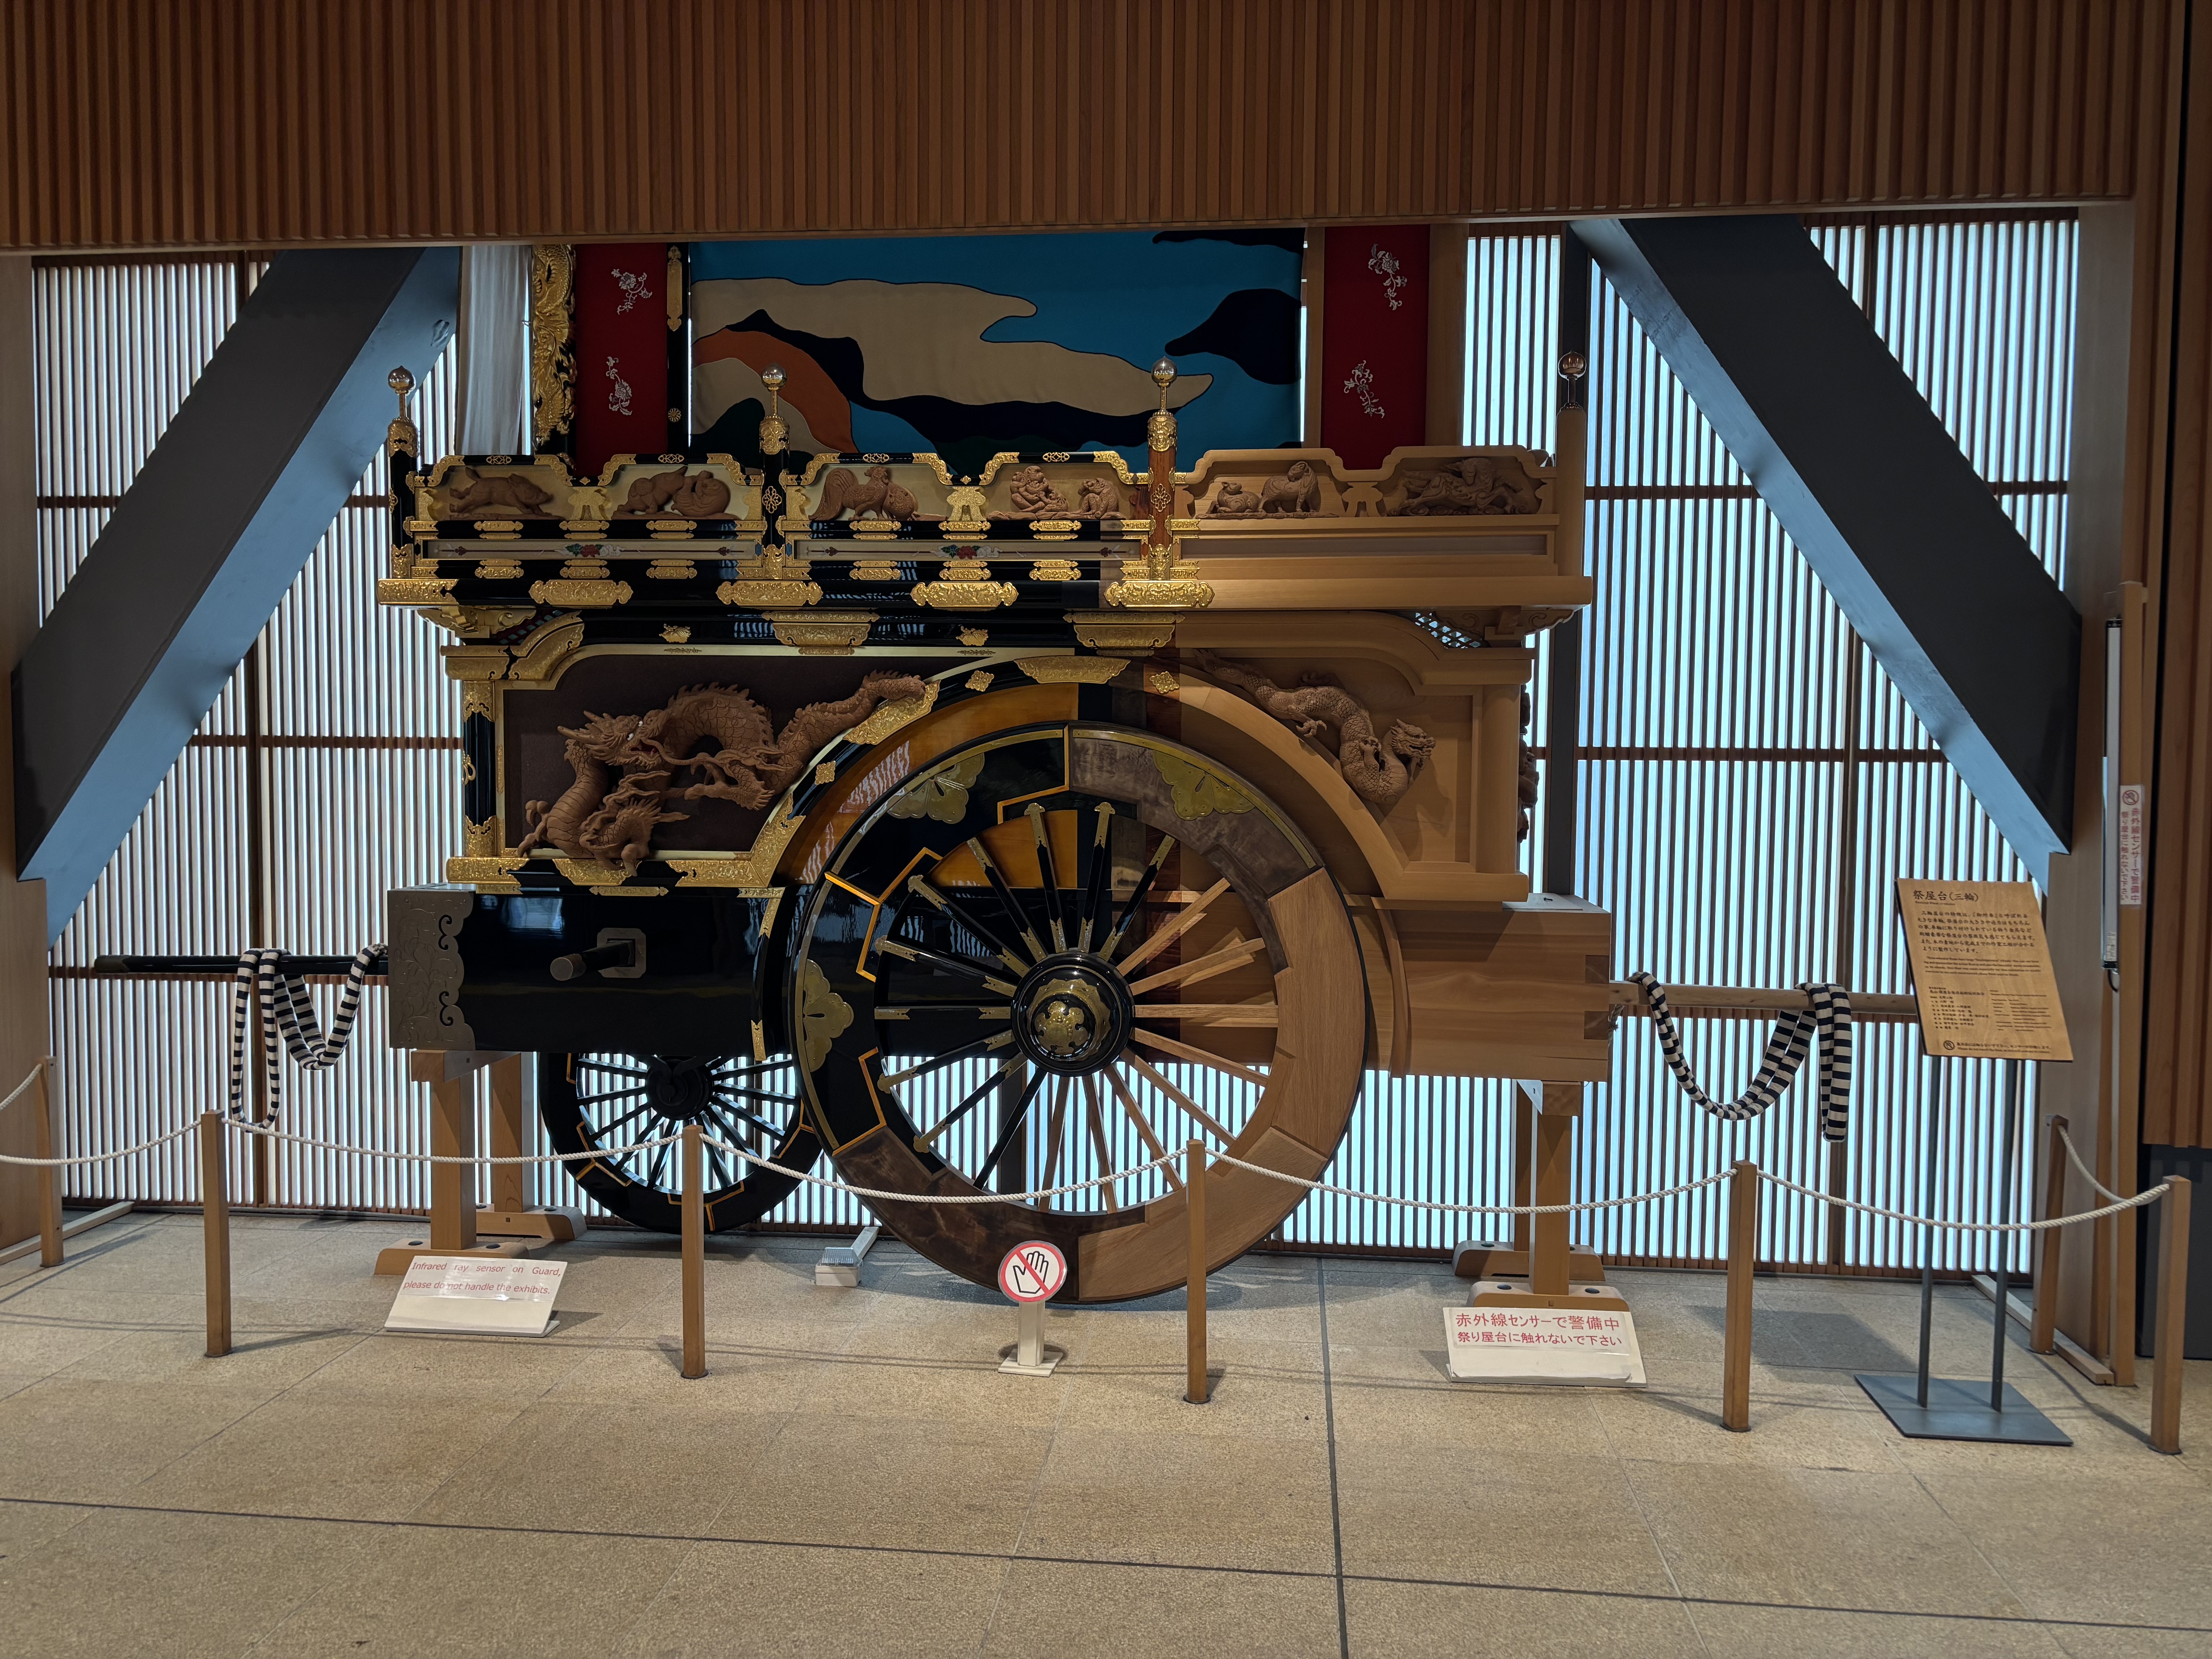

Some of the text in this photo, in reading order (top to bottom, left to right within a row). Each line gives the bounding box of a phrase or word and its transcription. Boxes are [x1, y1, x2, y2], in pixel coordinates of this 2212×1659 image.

[412, 1262, 447, 1270] Infrared
[532, 1267, 561, 1277] Guard,
[404, 1281, 431, 1290] please
[465, 1283, 494, 1291] handle
[497, 1283, 511, 1291] the
[514, 1285, 550, 1294] exhibits.
[1456, 1313, 1620, 1331] 赤外線センサーで警備中
[1458, 1331, 1622, 1346] 祭り屋台に触れないで下さい
